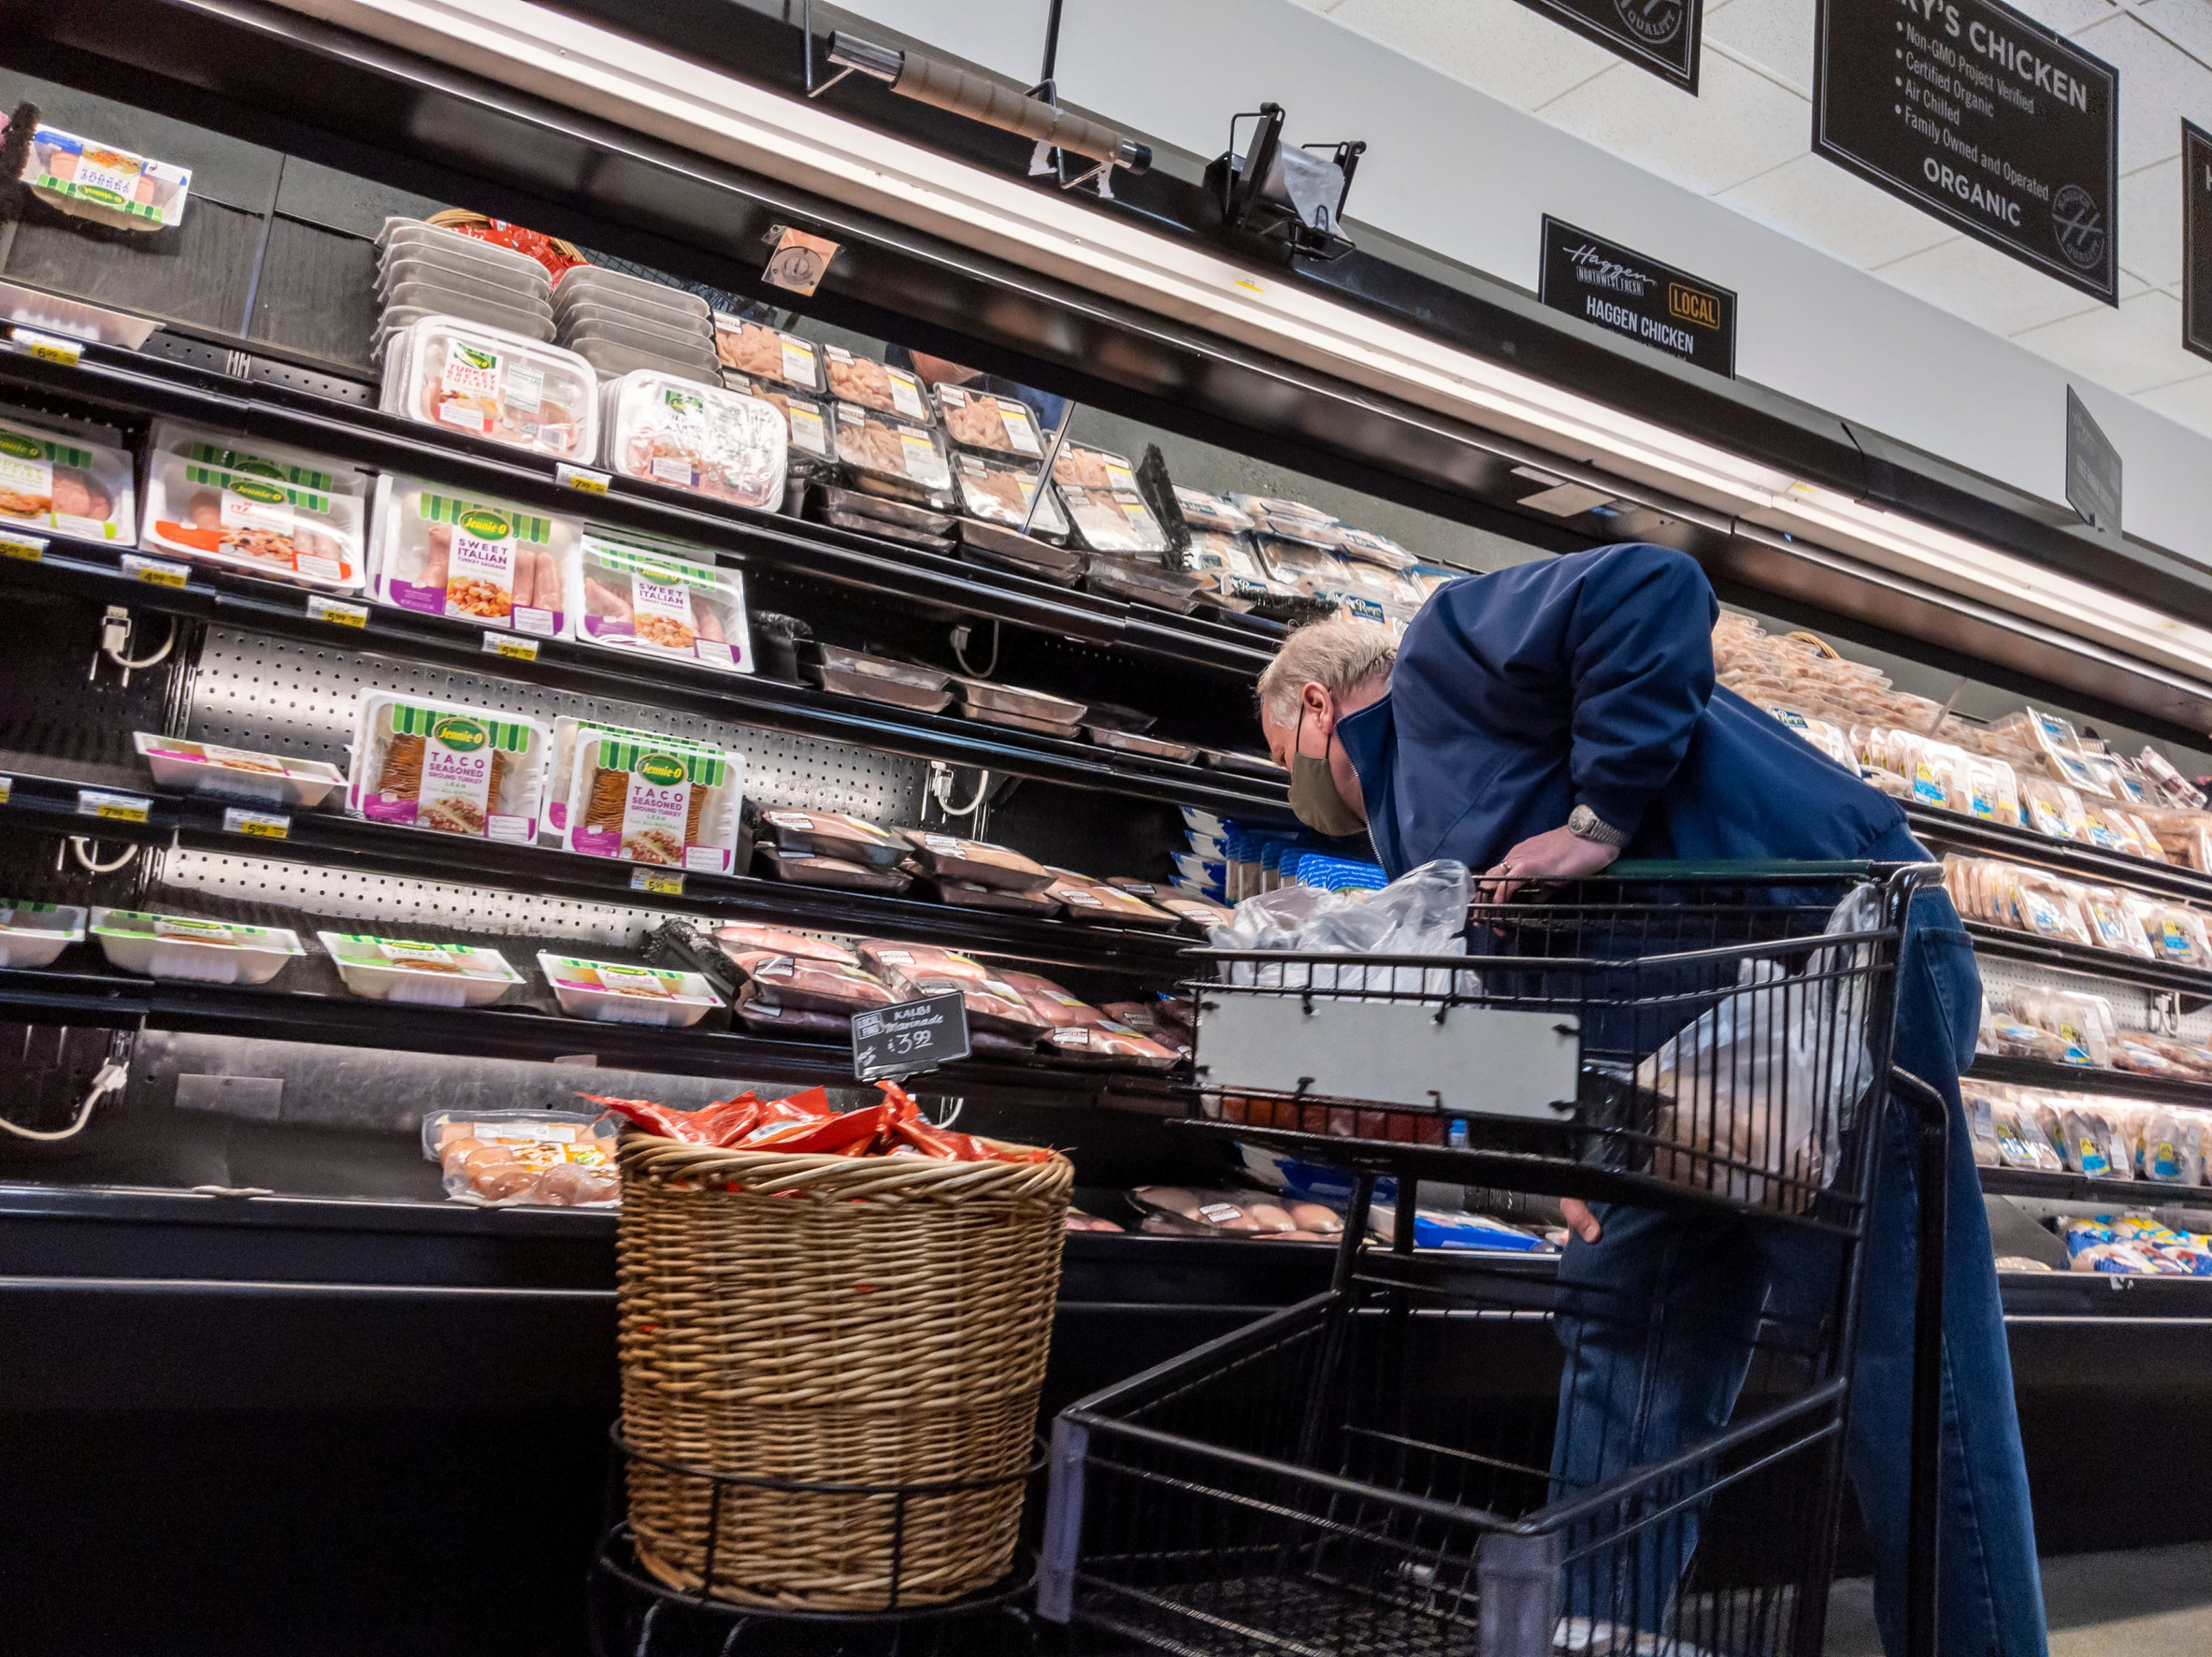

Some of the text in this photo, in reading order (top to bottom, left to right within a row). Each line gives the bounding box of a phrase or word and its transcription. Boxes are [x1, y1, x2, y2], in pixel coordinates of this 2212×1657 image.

[1906, 23, 2034, 114] Non-GMO Project Verified
[1969, 21, 2087, 112] CHICKEN
[1906, 51, 1994, 118] Certified Organic
[1905, 79, 1960, 126] Air Chilled
[1905, 106, 1940, 144] Family
[1943, 128, 1977, 163] Owned
[1981, 153, 2001, 176] and
[2003, 162, 2049, 201] Operated
[1924, 157, 2021, 227] ORGANIC
[1563, 244, 1658, 286] Haggen
[1578, 269, 1642, 295] NORTHWEST FRESH
[1673, 288, 1716, 324] LOCAL
[1587, 295, 1637, 333] HAGGEN
[1641, 316, 1694, 354] CHICKEN
[450, 363, 496, 380] TURKEY
[466, 517, 508, 535] Jennie-O
[458, 539, 509, 555] SWEET
[458, 547, 508, 565] ITALIAN
[639, 583, 683, 598] SWEET
[639, 589, 683, 606] ITALIAN
[438, 727, 483, 744] Jennie-O
[431, 751, 484, 770] TACO
[428, 762, 483, 778] SEASONED
[428, 771, 482, 785] GROUND TURKEY
[641, 762, 682, 779] Jennie-O
[634, 785, 683, 803] TACO
[631, 804, 682, 818] GROUND TURKEY
[632, 796, 682, 812] SEASONED
[894, 1004, 932, 1021] KALBI
